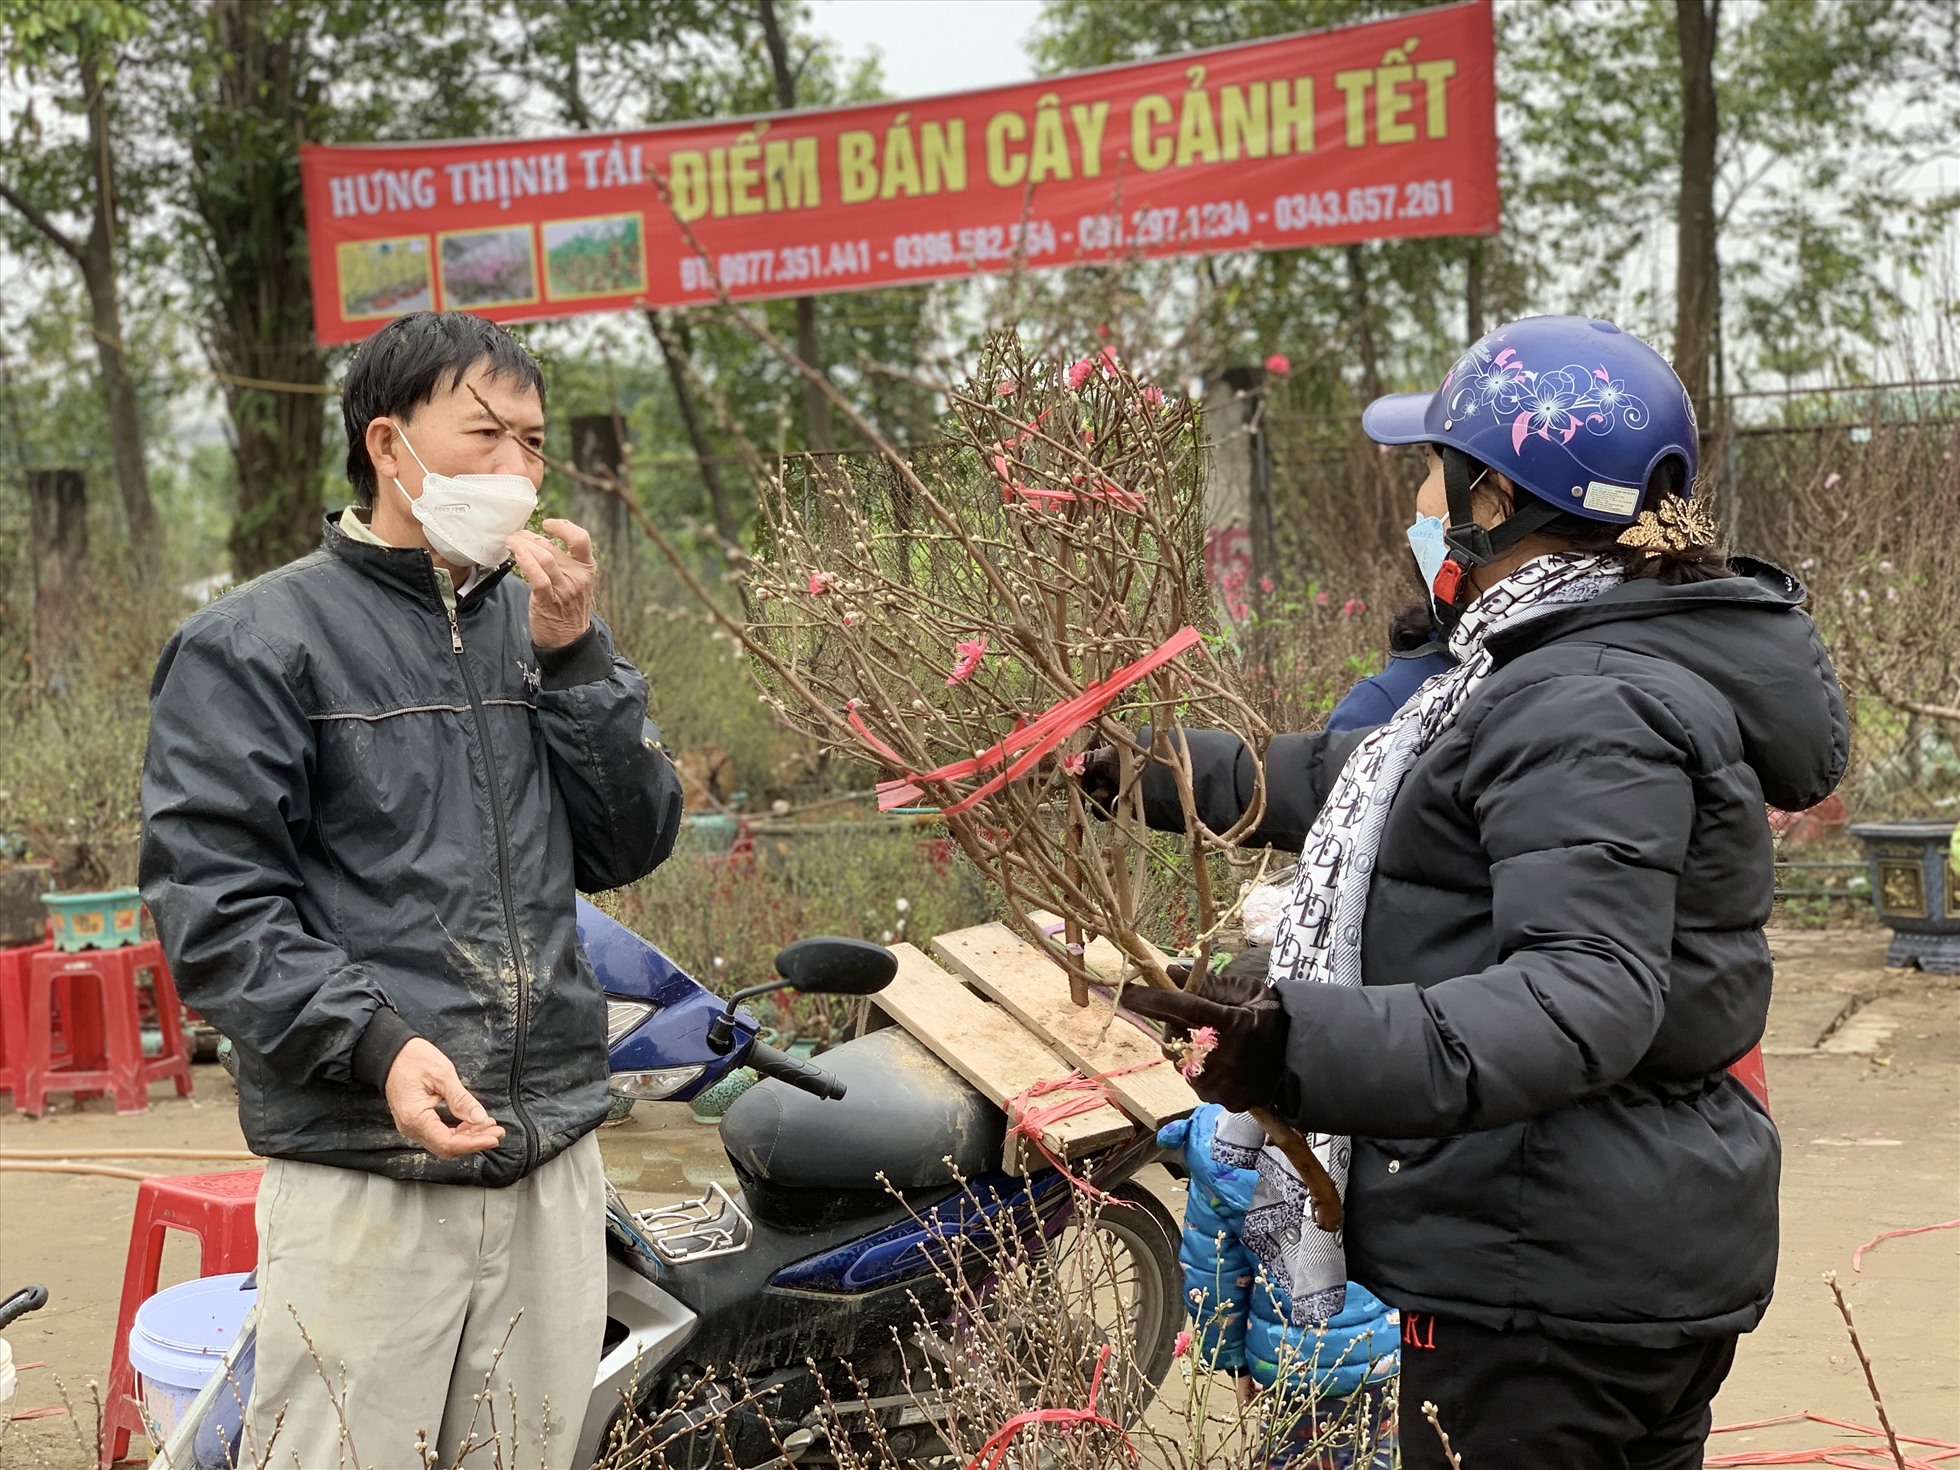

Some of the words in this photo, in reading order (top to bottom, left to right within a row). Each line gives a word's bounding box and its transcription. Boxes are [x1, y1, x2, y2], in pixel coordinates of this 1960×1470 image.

[668, 120, 821, 222] ĐIỂM
[837, 113, 967, 204] BÁN
[985, 92, 1111, 188] CÂY
[1130, 64, 1315, 172] CẢNH
[1335, 37, 1456, 148] TẾT
[329, 167, 437, 219] HƯNG
[446, 152, 568, 210] THỊNH
[1274, 180, 1454, 231] 0343.657.261
